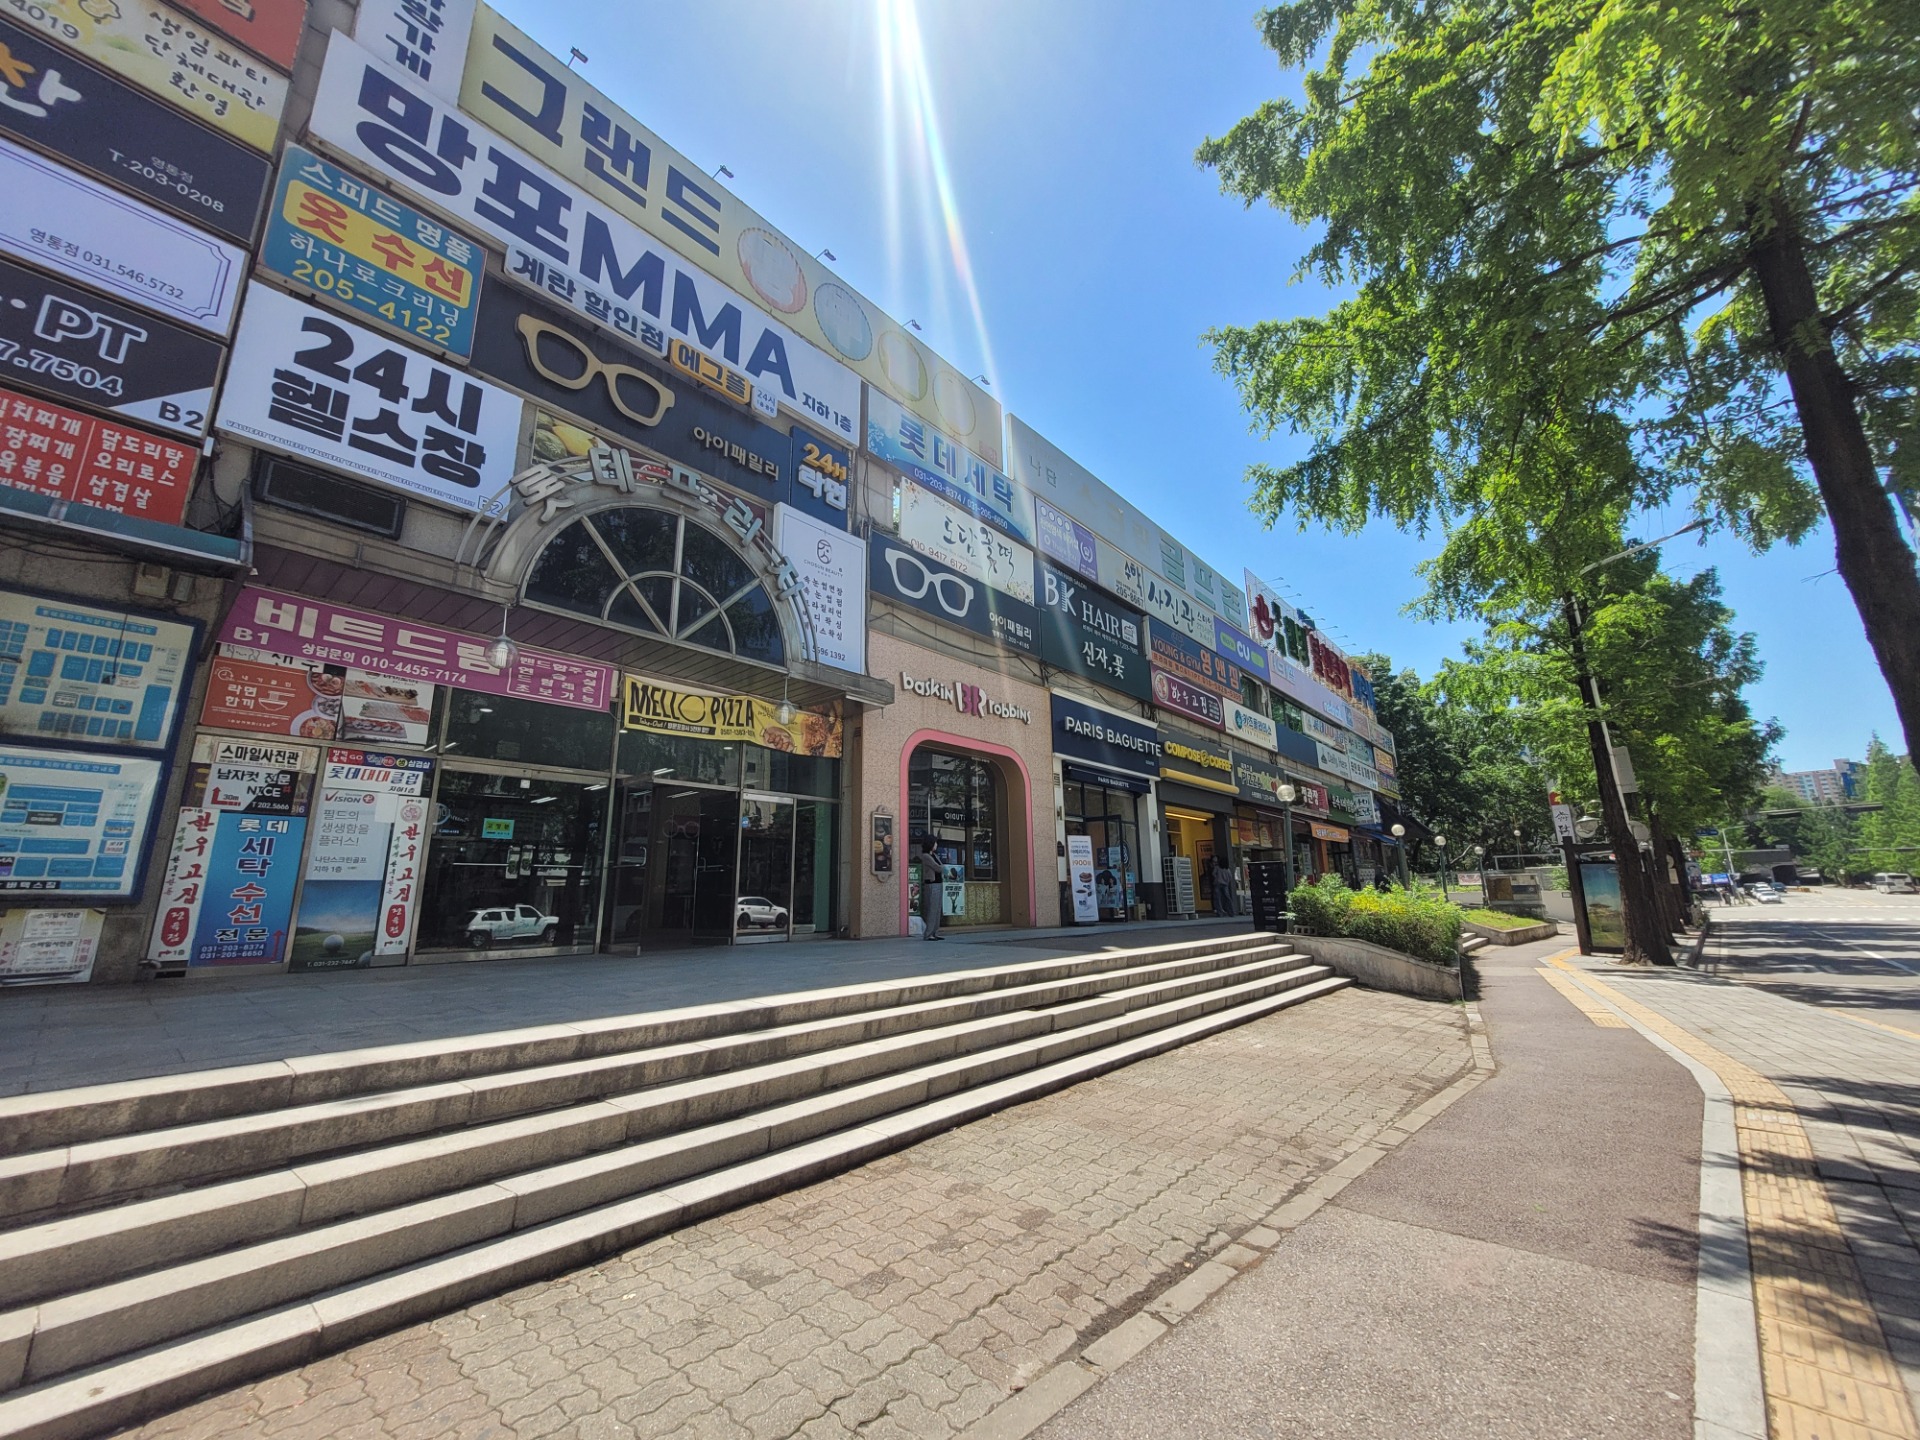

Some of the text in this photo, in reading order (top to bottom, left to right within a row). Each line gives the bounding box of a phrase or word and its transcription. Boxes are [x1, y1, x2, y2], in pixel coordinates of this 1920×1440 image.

[150, 11, 268, 85] 생일파티
[169, 70, 229, 117] 환영
[481, 33, 722, 258] 그랜드
[109, 148, 224, 213] T.203-0208
[300, 162, 472, 265] 스피드 명품
[30, 227, 184, 300] 영통점 031.546.5732
[297, 192, 465, 303] 옷 수선
[289, 232, 459, 327] 하나로크리닝
[292, 260, 451, 340] 205-4122
[513, 249, 664, 352] 계란 할인점
[35, 294, 147, 364] PT
[293, 316, 483, 436] 24시
[159, 400, 204, 430] B2
[268, 368, 487, 488] 헬스장
[803, 392, 852, 433] 지하 1층
[94, 452, 175, 486] 오리로스
[102, 429, 184, 469] 닭도리탕
[693, 426, 779, 481] 아이패밀리
[803, 442, 847, 481] 24H
[899, 414, 1013, 512] 롯데세탁
[89, 475, 152, 509] 삼겹살
[799, 465, 847, 511] 라면
[914, 467, 962, 503] 031-203-8374
[967, 498, 1009, 530] 031-205-6650
[804, 560, 843, 577] CHOSUN BEAUTY
[928, 549, 947, 564] 9417
[949, 558, 968, 573] 6172
[1044, 570, 1077, 616] BK
[1160, 538, 1242, 628] 골프존
[989, 612, 1032, 641] 아이패밀리
[1082, 600, 1121, 638] HAIR
[1148, 581, 1194, 633] 사진관
[233, 628, 270, 645] B1
[830, 650, 847, 661] 1392
[1152, 636, 1178, 659] YOUNG
[1237, 641, 1250, 661] CU
[302, 642, 355, 664] 상담문의
[361, 655, 467, 685] 010-4455-7174
[228, 684, 257, 697] 라면
[630, 682, 755, 728] MELLO PIZZA
[902, 672, 955, 704] baskin
[989, 699, 1031, 725] robbins
[1170, 682, 1208, 715] 한우고집
[221, 745, 300, 765] 스마일사진관
[1064, 716, 1162, 757] PARIS BAGUETTE
[1164, 741, 1232, 771] COMPOSE COFFEE
[218, 768, 291, 785] 남자컷 전문
[247, 786, 281, 798] NICE
[1301, 785, 1319, 805] 정관장
[323, 809, 359, 822] 필드의
[325, 791, 361, 804] VISION
[239, 817, 289, 834] 롯데
[318, 835, 359, 847] 플러스!
[322, 822, 369, 835] 생생함을
[172, 812, 215, 905] 한우고집
[236, 837, 274, 877] 세탁
[393, 824, 421, 903] 한우고집
[229, 882, 267, 925] 수선
[216, 927, 268, 943] 전문
